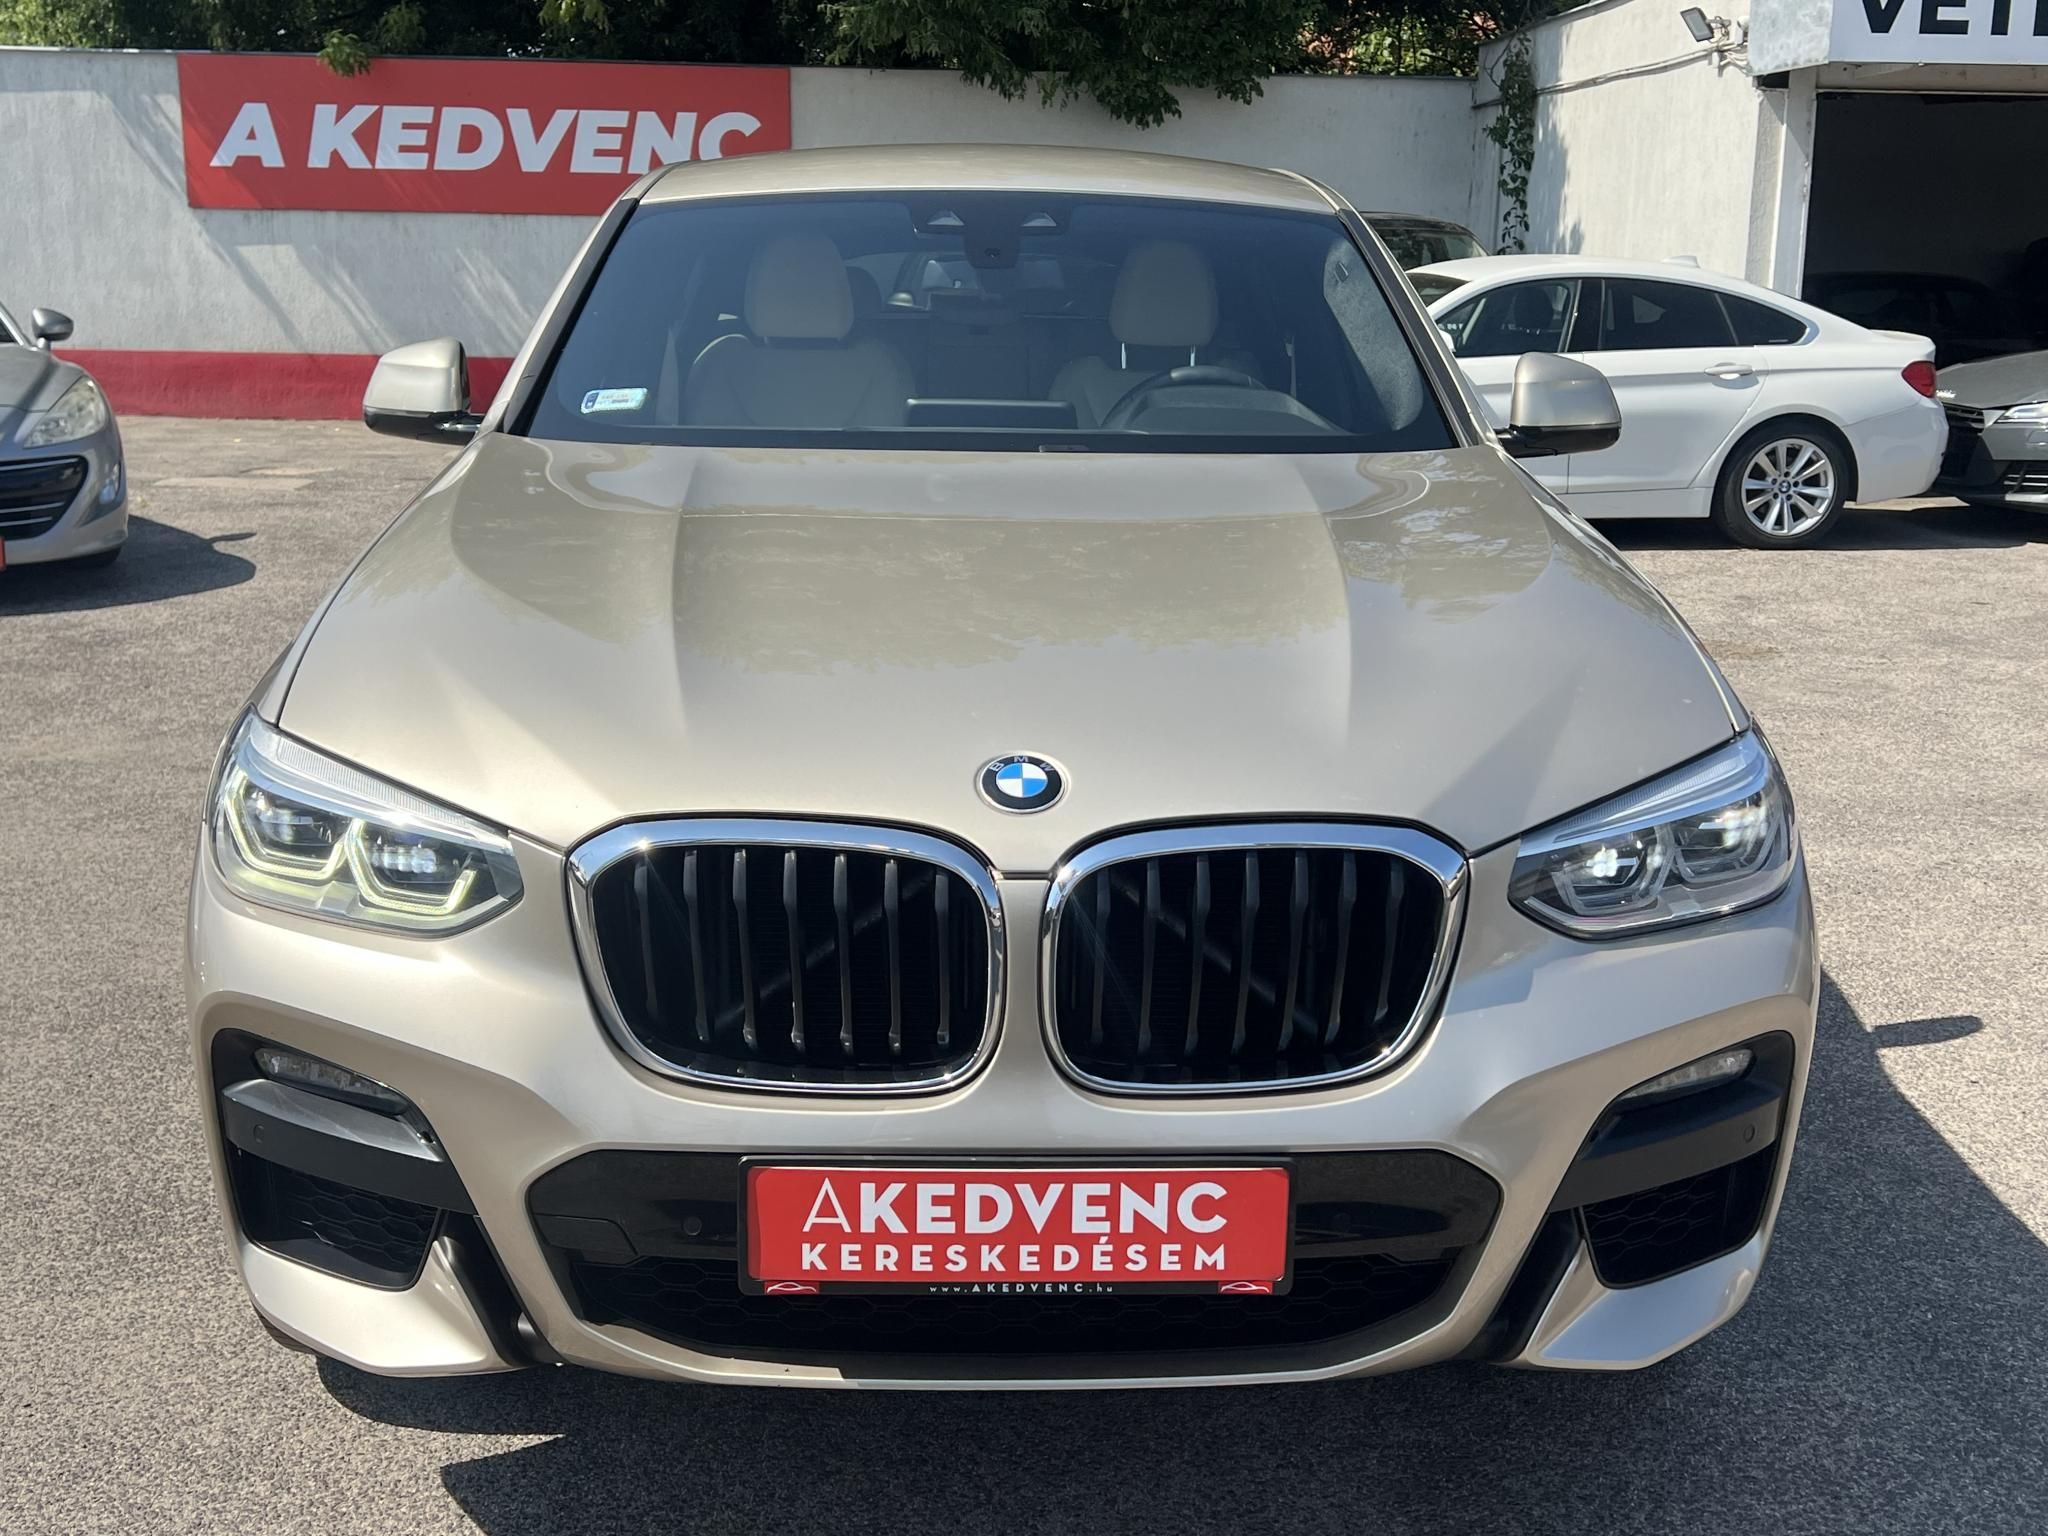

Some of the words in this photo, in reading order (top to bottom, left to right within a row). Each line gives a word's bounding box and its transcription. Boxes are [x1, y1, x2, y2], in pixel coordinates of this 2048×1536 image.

[210, 102, 285, 168] A
[307, 103, 762, 175] KEDVENC
[989, 755, 1055, 772] BMW
[801, 1236, 1226, 1271] KERESKEDÉSEM
[929, 1283, 1113, 1293] www.AKEDVENC.hu
